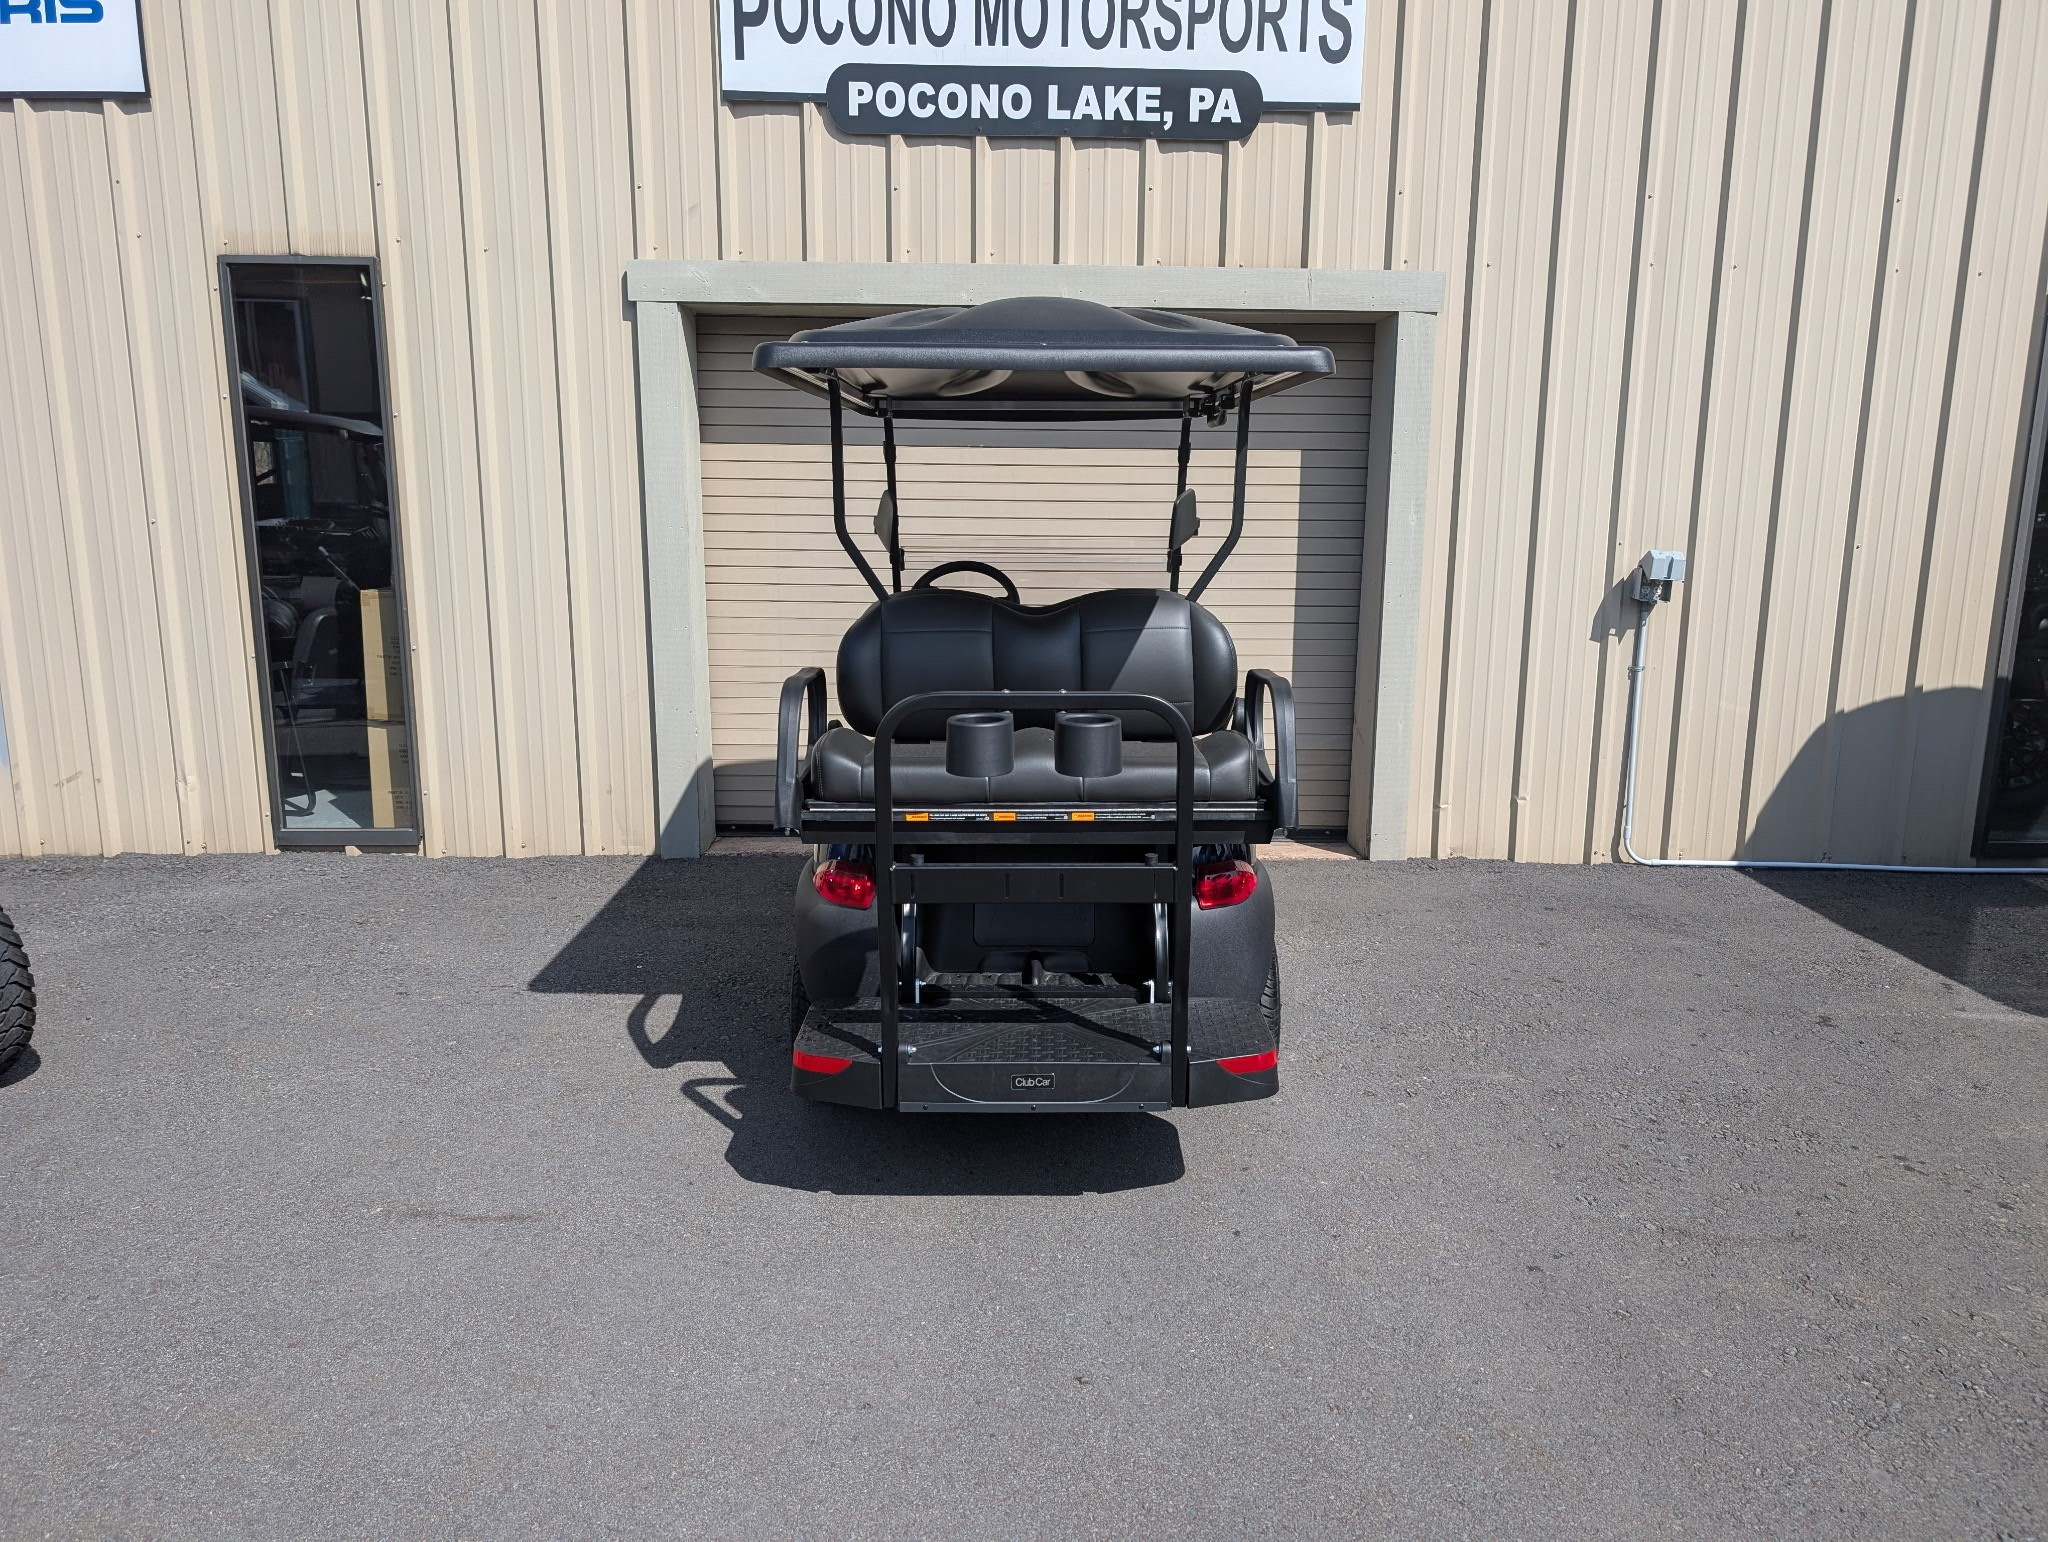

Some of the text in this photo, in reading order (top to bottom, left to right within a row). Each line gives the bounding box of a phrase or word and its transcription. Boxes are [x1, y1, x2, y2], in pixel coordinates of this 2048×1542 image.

[733, 0, 1353, 64] POCONO MOTORSPORTS
[848, 81, 1242, 131] POCONO LAKE, PA
